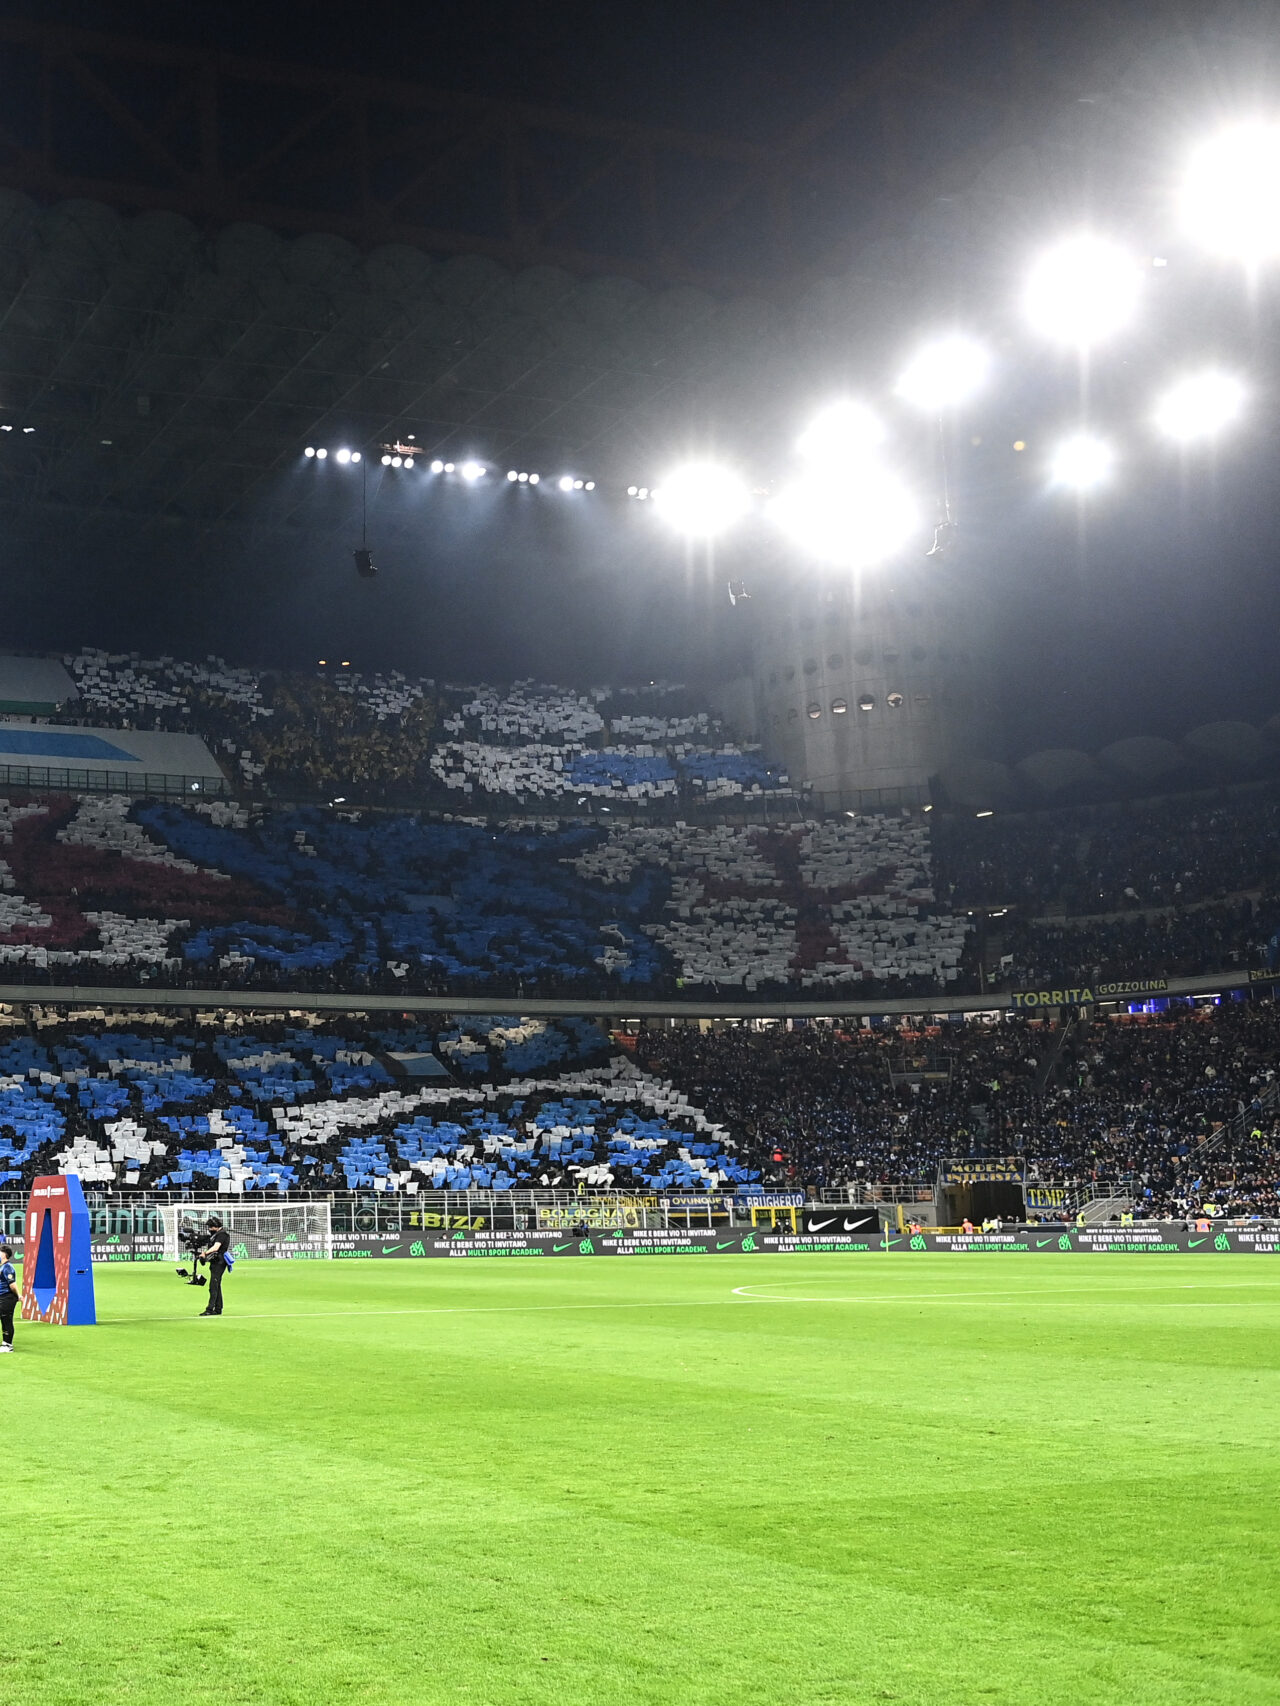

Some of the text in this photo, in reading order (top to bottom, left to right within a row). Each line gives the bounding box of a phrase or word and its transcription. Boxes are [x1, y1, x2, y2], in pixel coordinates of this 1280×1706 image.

[1099, 979, 1167, 994] GOZZOLINA
[1013, 988, 1094, 1008] TORRITA
[950, 1163, 1017, 1173] MODENA
[946, 1173, 1022, 1182] INTERISTA
[746, 1194, 803, 1207] BRUGHERIO
[540, 1208, 622, 1219] BOLOGNA
[548, 1220, 618, 1228] NERAZURRA
[369, 1232, 400, 1240] INVTANO
[764, 1236, 778, 1244] NIKE
[785, 1236, 800, 1244] BEBE
[801, 1236, 812, 1244] VIO
[813, 1236, 819, 1244] TI
[820, 1236, 851, 1244] INVITANO
[936, 1235, 951, 1243] NIKE
[957, 1235, 973, 1243] BEBE
[973, 1235, 983, 1243] VIO
[984, 1235, 989, 1243] TI
[990, 1235, 1015, 1243] INVITANO
[1238, 1234, 1254, 1242] NIKE
[1261, 1234, 1279, 1242] BEBE
[434, 1241, 450, 1249] NIKE
[457, 1241, 473, 1249] BEBE
[474, 1241, 487, 1249] VIO
[487, 1241, 494, 1249] TI
[495, 1241, 527, 1249] INVITANO
[1092, 1243, 1179, 1251] ALLA MULTI SPORT ACADEMY.
[1255, 1243, 1273, 1251] ALLA
[313, 1251, 337, 1259] SPOT
